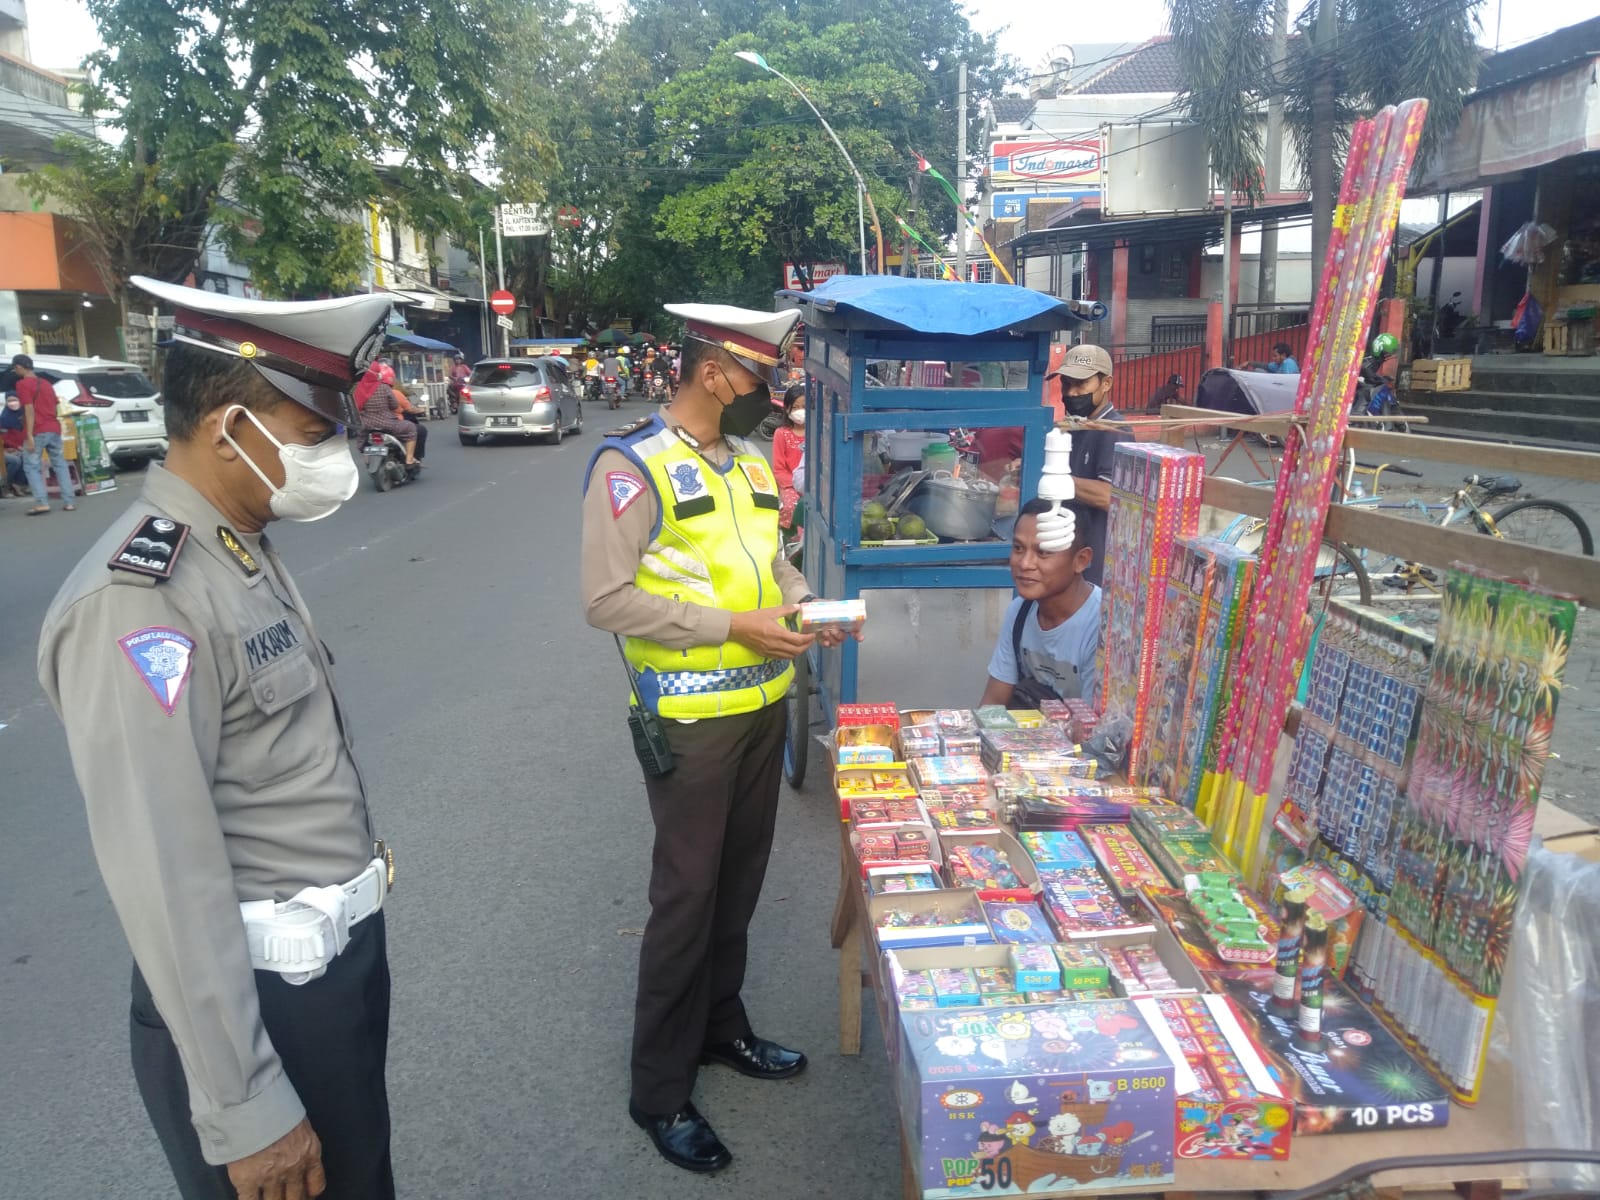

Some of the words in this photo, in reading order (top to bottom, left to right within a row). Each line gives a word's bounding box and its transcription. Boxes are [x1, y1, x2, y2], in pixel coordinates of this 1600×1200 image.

[1015, 154, 1098, 171] Indomaret
[503, 207, 533, 215] SENTRA
[1075, 355, 1092, 366] Lee
[119, 553, 166, 570] POLISI
[1084, 976, 1101, 985] PCS
[1117, 1079, 1129, 1091] B
[1131, 1077, 1166, 1089] 8500
[1352, 1107, 1378, 1126] 10
[1387, 1103, 1434, 1124] PCS
[942, 1158, 980, 1177] POP
[980, 1157, 1012, 1190] 50
